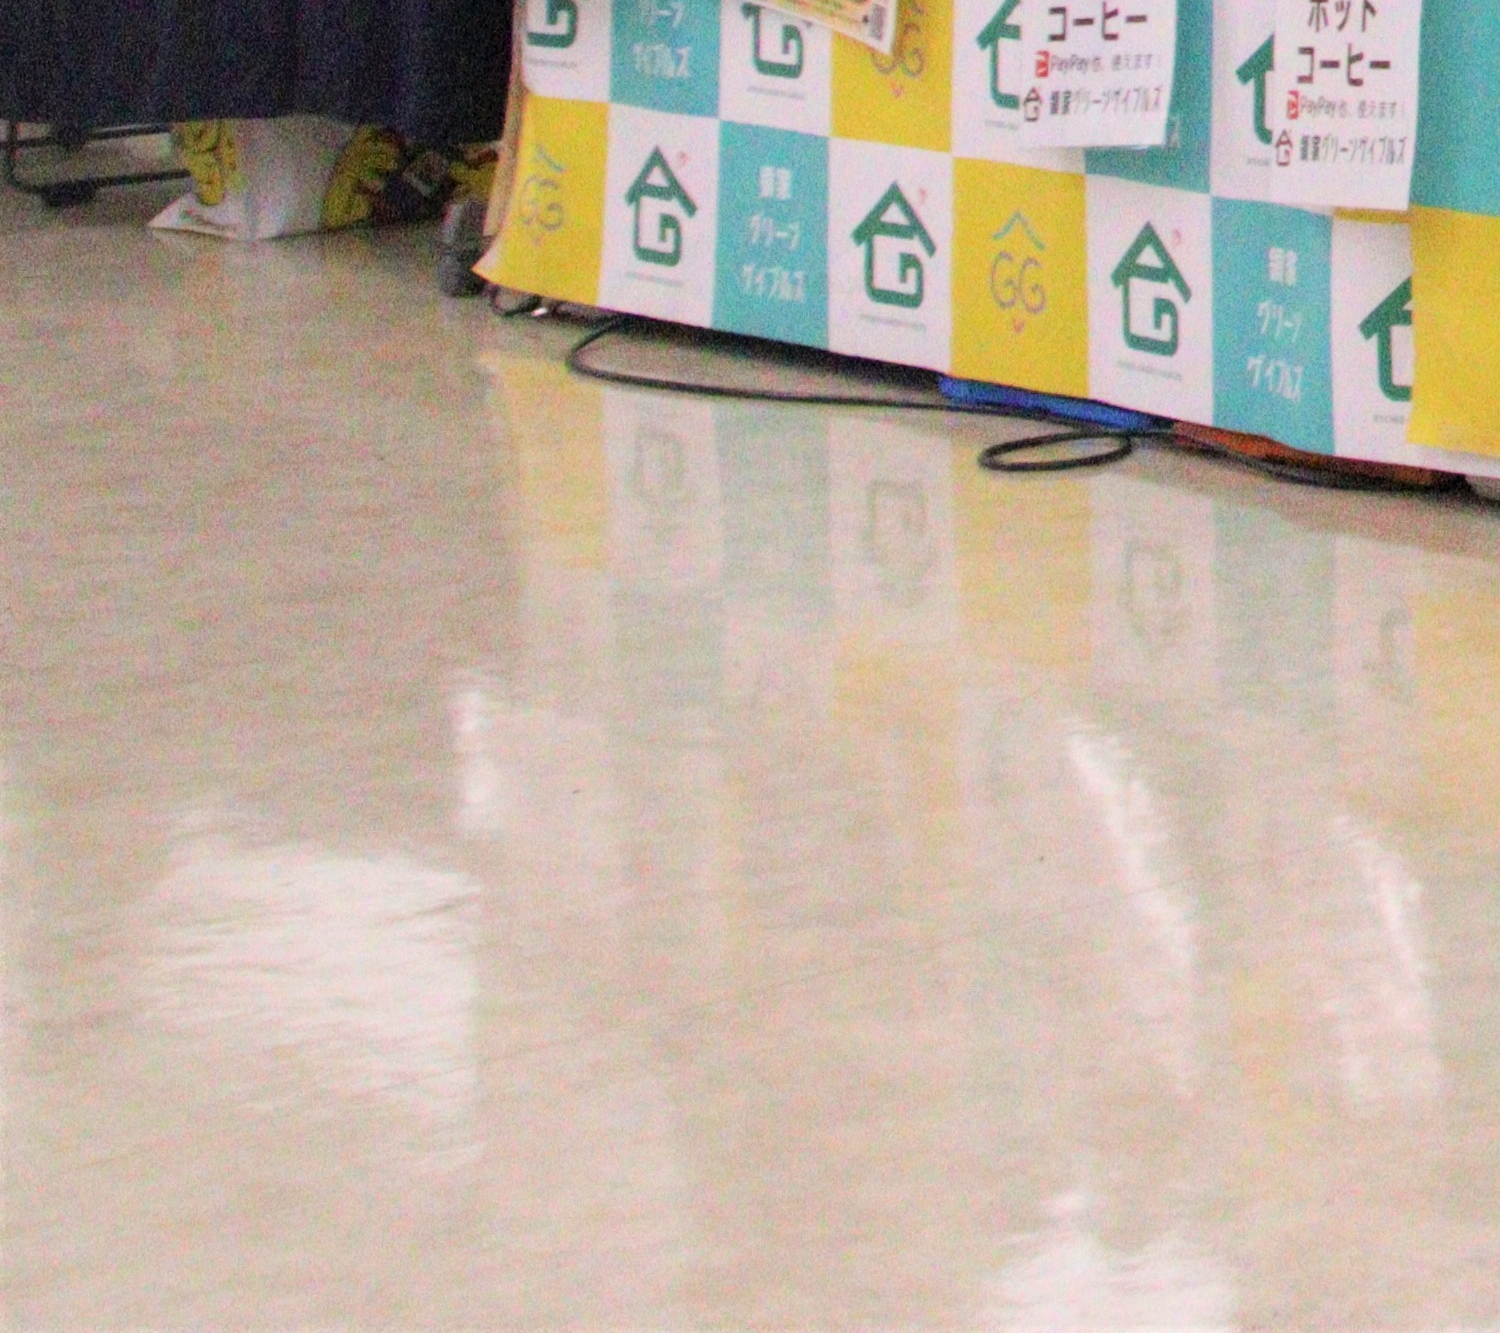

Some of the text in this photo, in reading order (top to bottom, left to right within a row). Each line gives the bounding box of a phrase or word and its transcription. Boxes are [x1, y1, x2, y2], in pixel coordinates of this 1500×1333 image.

[1047, 0, 1148, 44] コーヒー
[1296, 40, 1391, 88] コーヒー
[989, 250, 1048, 317] GG
